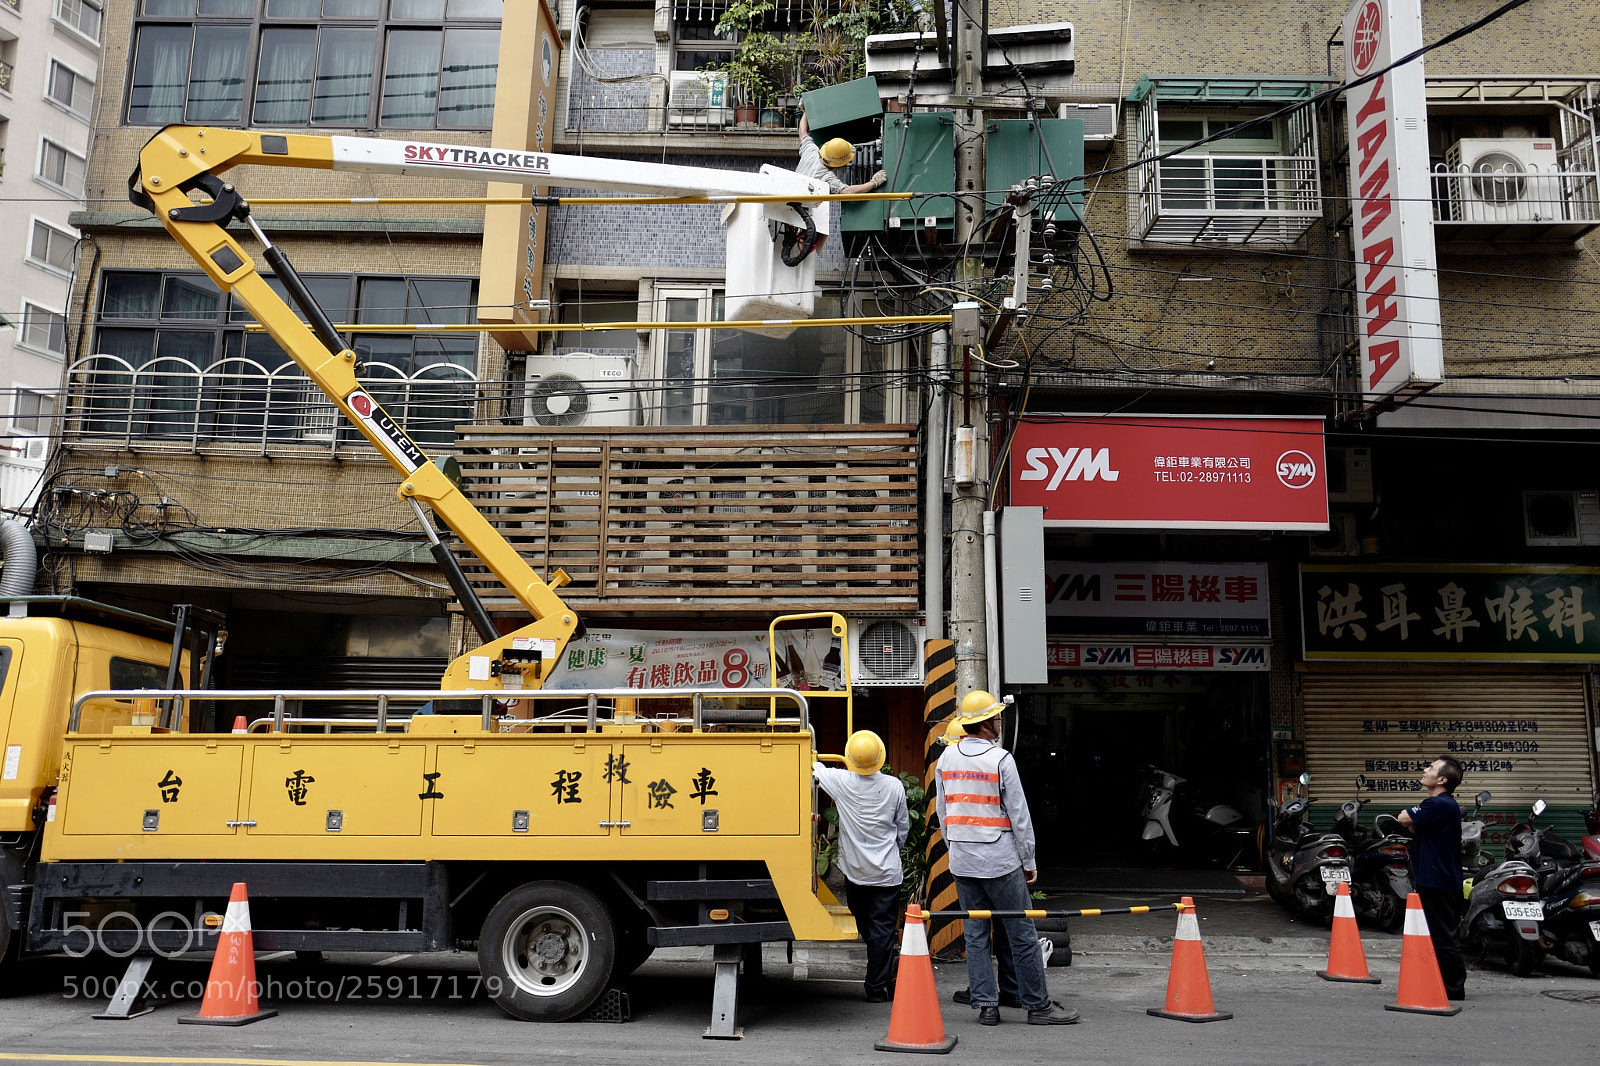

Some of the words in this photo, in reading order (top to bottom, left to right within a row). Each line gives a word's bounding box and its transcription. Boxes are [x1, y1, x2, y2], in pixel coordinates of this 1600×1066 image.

[404, 145, 549, 169] SKYTRACKER
[1356, 67, 1401, 391] YAMAHA
[380, 417, 420, 460] UTEM
[1020, 447, 1120, 491] SYM
[1154, 456, 1251, 469] 偉鉅車業有限公司
[1154, 471, 1251, 483] TEL:02-28971113
[1114, 574, 1258, 603] 三陽機車
[1318, 582, 1595, 644] 洪耳鼻喉科
[1145, 620, 1198, 632] 偉鉅車業
[567, 643, 646, 670] 健康一夏
[1084, 648, 1131, 664] SYM
[1137, 648, 1210, 664] 三陽機車
[1217, 648, 1265, 665] SYM
[1505, 907, 1542, 918] 035-ESG
